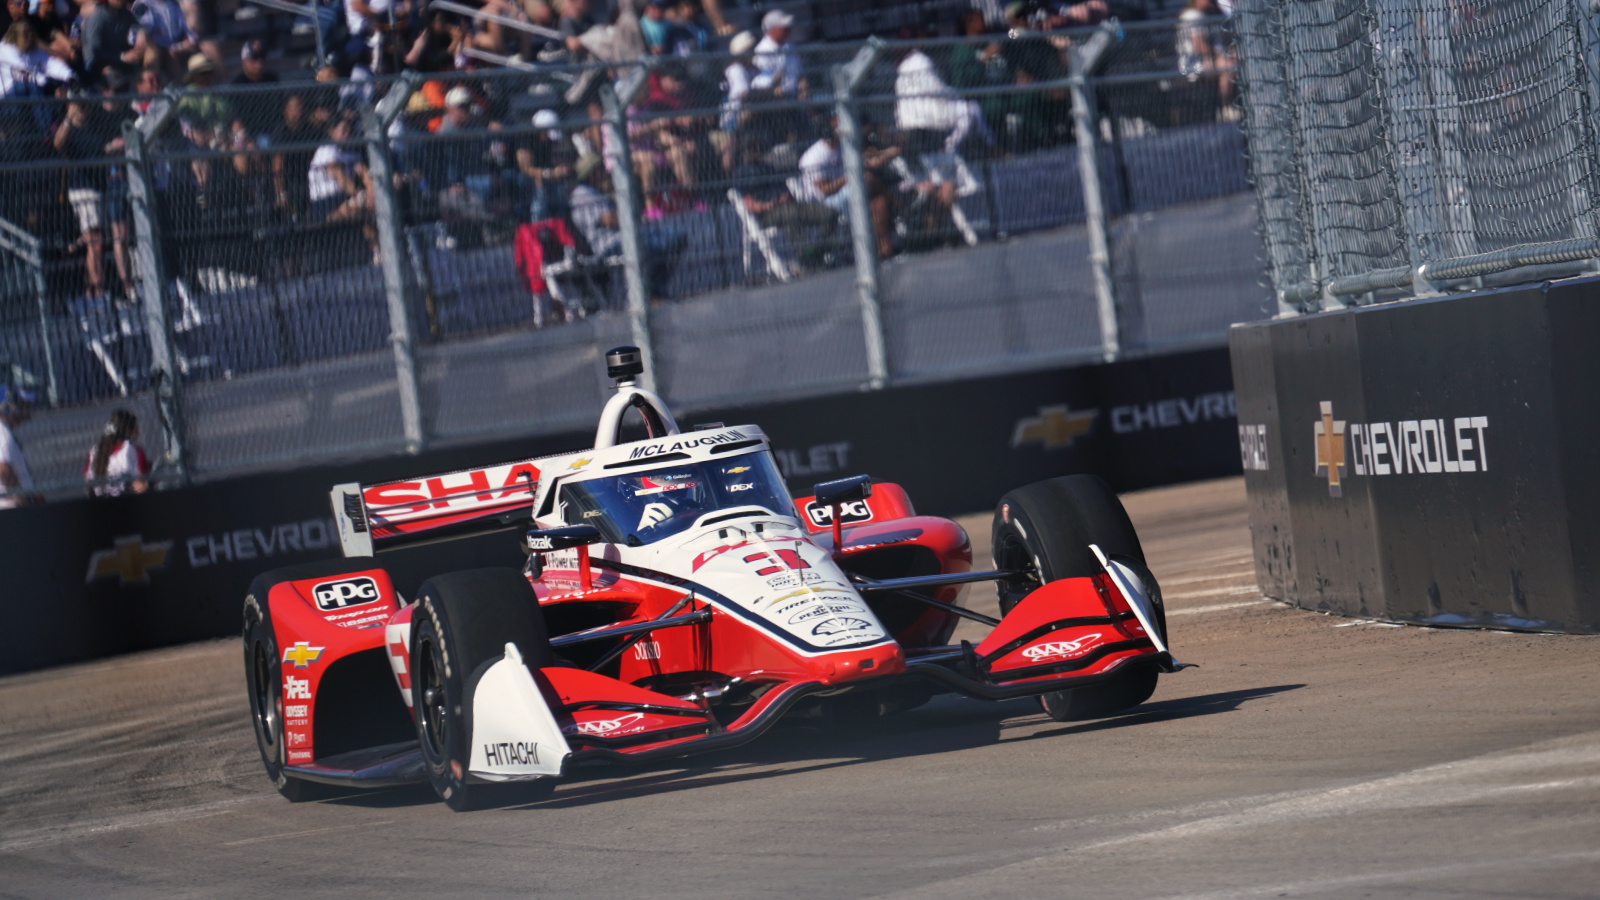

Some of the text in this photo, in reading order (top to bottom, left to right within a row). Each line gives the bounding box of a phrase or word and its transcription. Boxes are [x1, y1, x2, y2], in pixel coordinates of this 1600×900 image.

[629, 430, 747, 459] MCLAUGHLIN
[1351, 415, 1488, 476] CHEVROLET
[730, 482, 753, 492] DEX
[743, 549, 811, 576] 3
[317, 583, 375, 607] PPG
[1027, 641, 1077, 657] AAA
[1060, 642, 1105, 659] Travel
[484, 742, 540, 766] HITACHI
